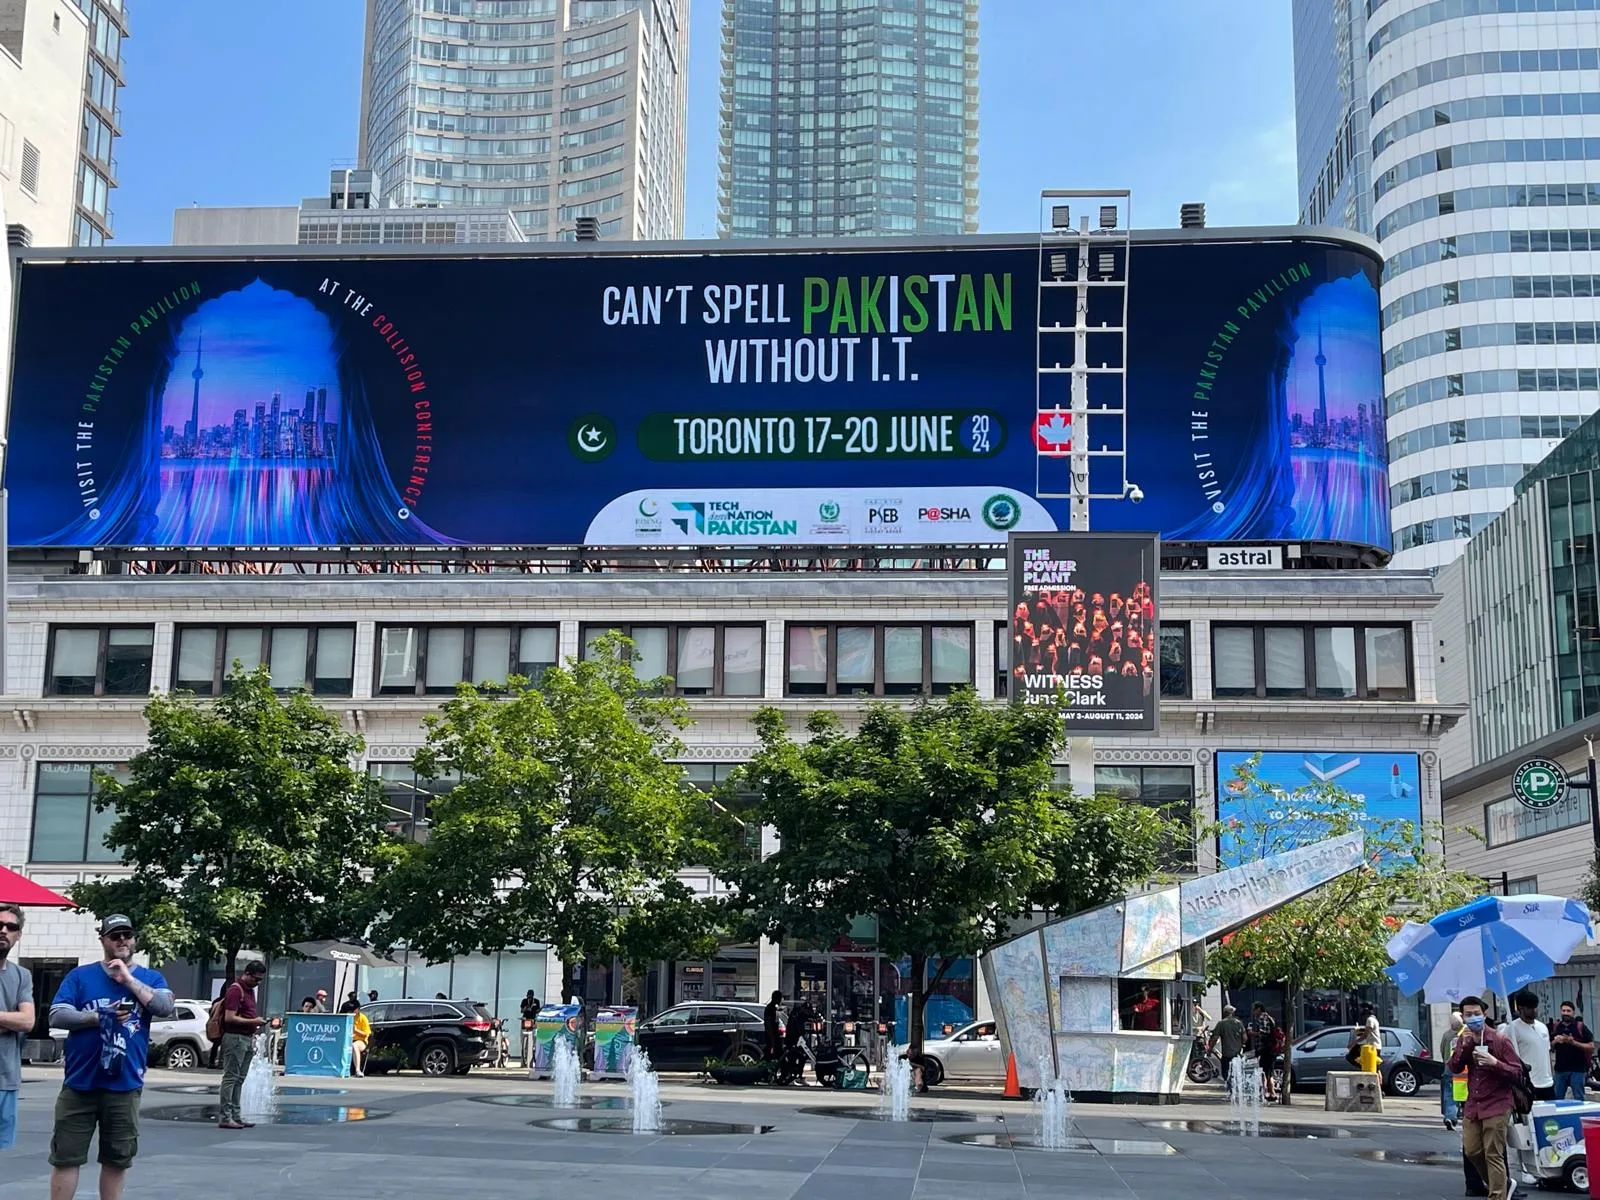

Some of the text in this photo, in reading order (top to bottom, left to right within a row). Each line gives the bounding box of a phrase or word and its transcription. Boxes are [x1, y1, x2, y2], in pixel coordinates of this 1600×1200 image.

[602, 272, 1013, 335] CAN'T SPELL PAKISTAN
[705, 336, 919, 384] WITHOUT I.T.
[1191, 261, 1312, 500] VISIT THE PAKISTAN PAVILION
[76, 281, 201, 507] VISIT THE PAKISTAN PAVILION
[318, 278, 433, 508] AT THE COLLISION CONFERENCE
[971, 414, 990, 433] 20
[673, 415, 953, 455] TORONTO 17-20 JUNE
[971, 433, 990, 453] 24
[709, 501, 739, 511] TECH
[918, 507, 971, 521] P@SHA
[707, 519, 798, 536] PAKISTAN
[1023, 548, 1051, 560] THE
[1218, 549, 1273, 566] astral
[1023, 560, 1078, 572] POWER
[1023, 571, 1072, 584] PLANT
[1023, 584, 1078, 592] FREE ADMISSION
[1023, 673, 1104, 689] WITNESS
[1058, 712, 1076, 720] MAY
[1125, 712, 1144, 720] 2024
[1515, 761, 1563, 783] MUNICIPAL
[1529, 772, 1550, 792] P
[1517, 788, 1563, 807] PARKING
[1186, 840, 1358, 914] Visitor Information
[1523, 902, 1541, 914] Silk
[1459, 913, 1476, 927] Silk
[295, 1021, 340, 1034] ONTARIO
